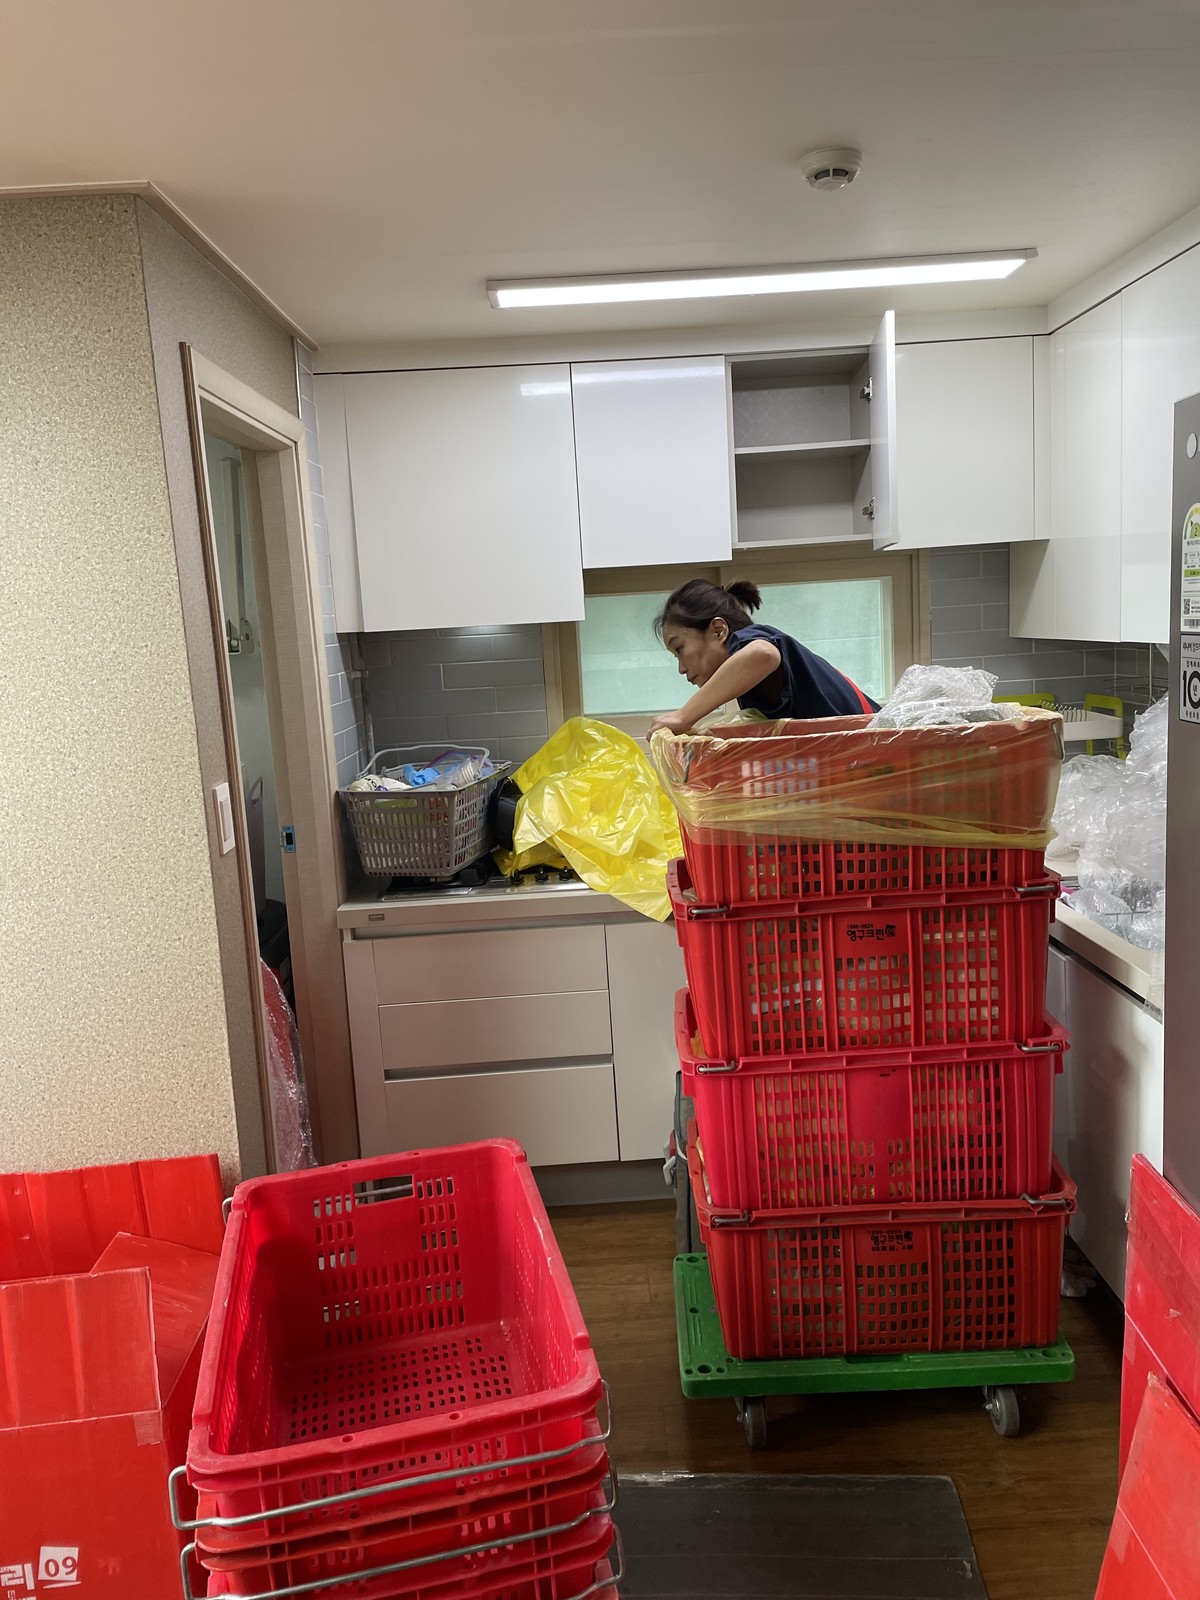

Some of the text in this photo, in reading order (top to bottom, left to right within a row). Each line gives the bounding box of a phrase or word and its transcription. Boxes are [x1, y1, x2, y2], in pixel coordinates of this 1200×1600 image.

[847, 929, 884, 941] 영구크린
[871, 1235, 903, 1246] 영구크린
[44, 1556, 78, 1578] 09
